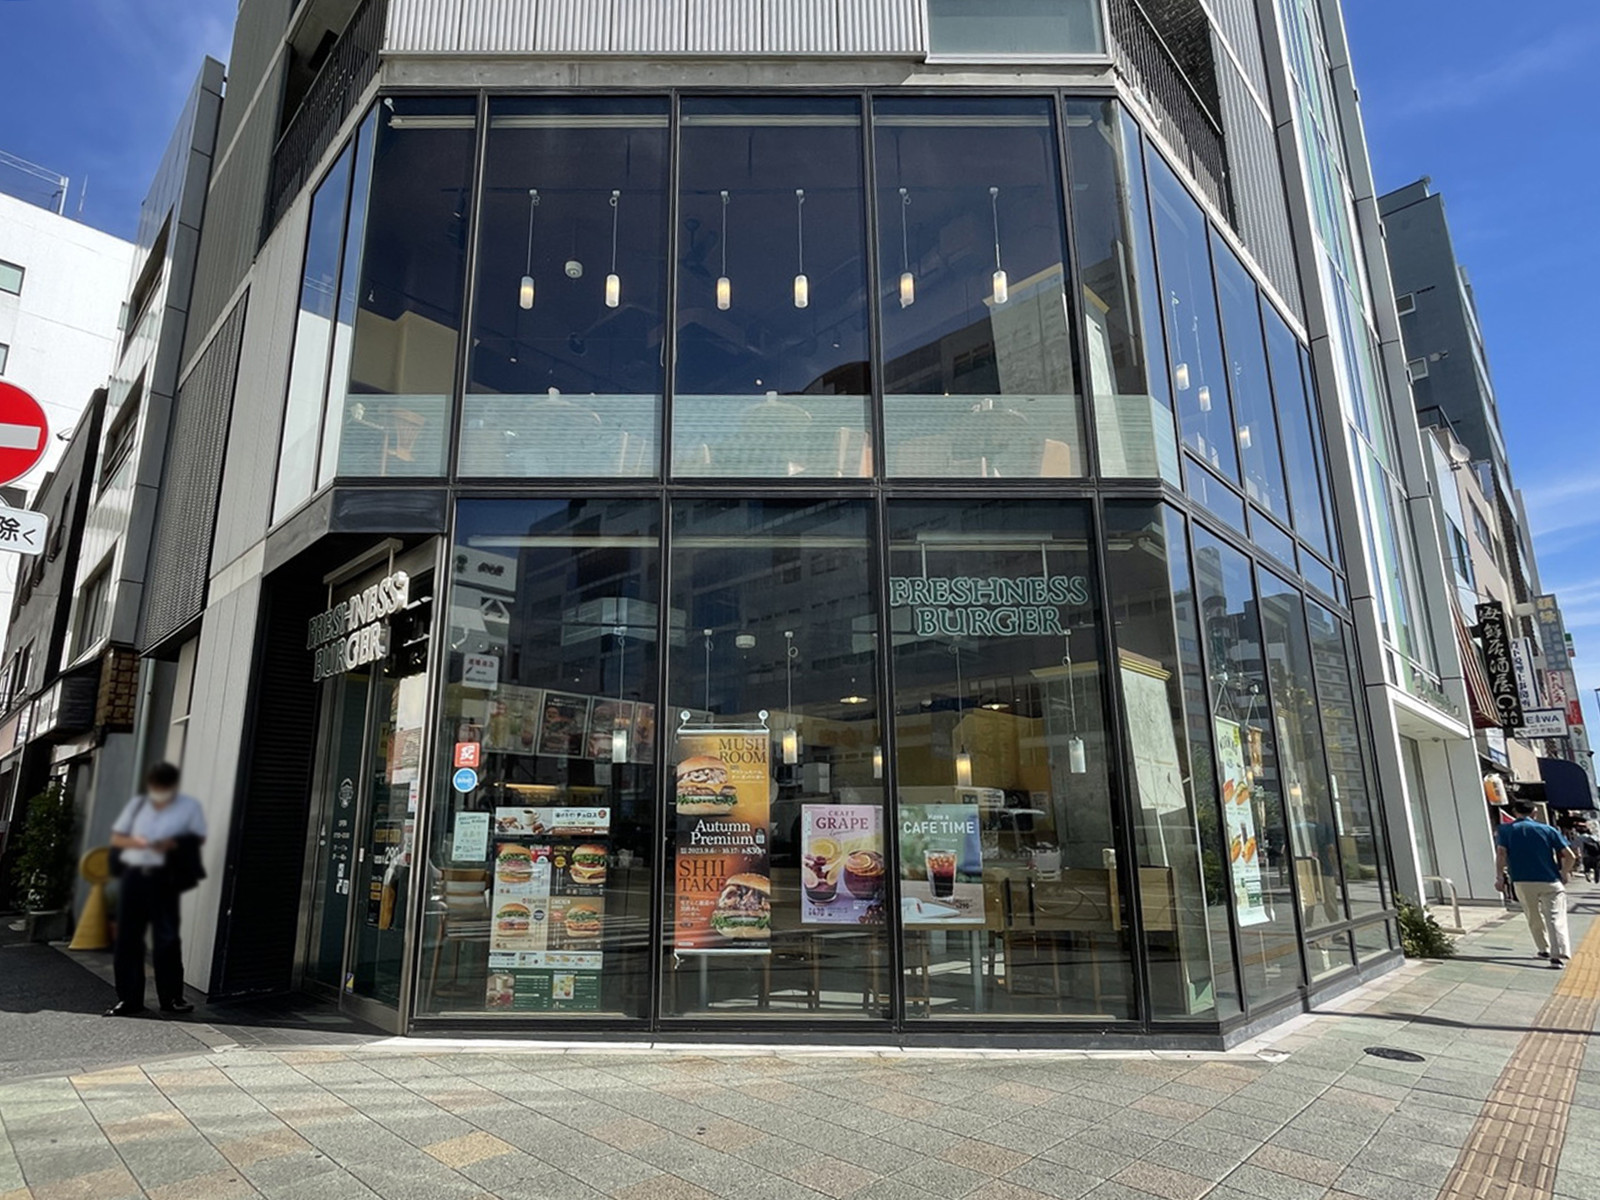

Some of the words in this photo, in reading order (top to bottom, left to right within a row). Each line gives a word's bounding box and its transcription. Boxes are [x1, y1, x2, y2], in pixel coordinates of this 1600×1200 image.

[0, 516, 36, 545] 除く
[889, 576, 1088, 606] FRESHNESS
[306, 570, 409, 650] FRESHNESS
[916, 607, 1064, 636] BURGER
[313, 621, 388, 682] BURGER
[719, 738, 767, 750] MUSH
[720, 751, 767, 764] ROOM
[695, 819, 751, 832] Autumn
[816, 817, 869, 830] GRAPE
[903, 821, 937, 834] CAFE
[940, 821, 975, 834] TIME
[690, 832, 754, 846] Premium
[679, 860, 726, 877] SHII
[679, 878, 726, 892] TAKE
